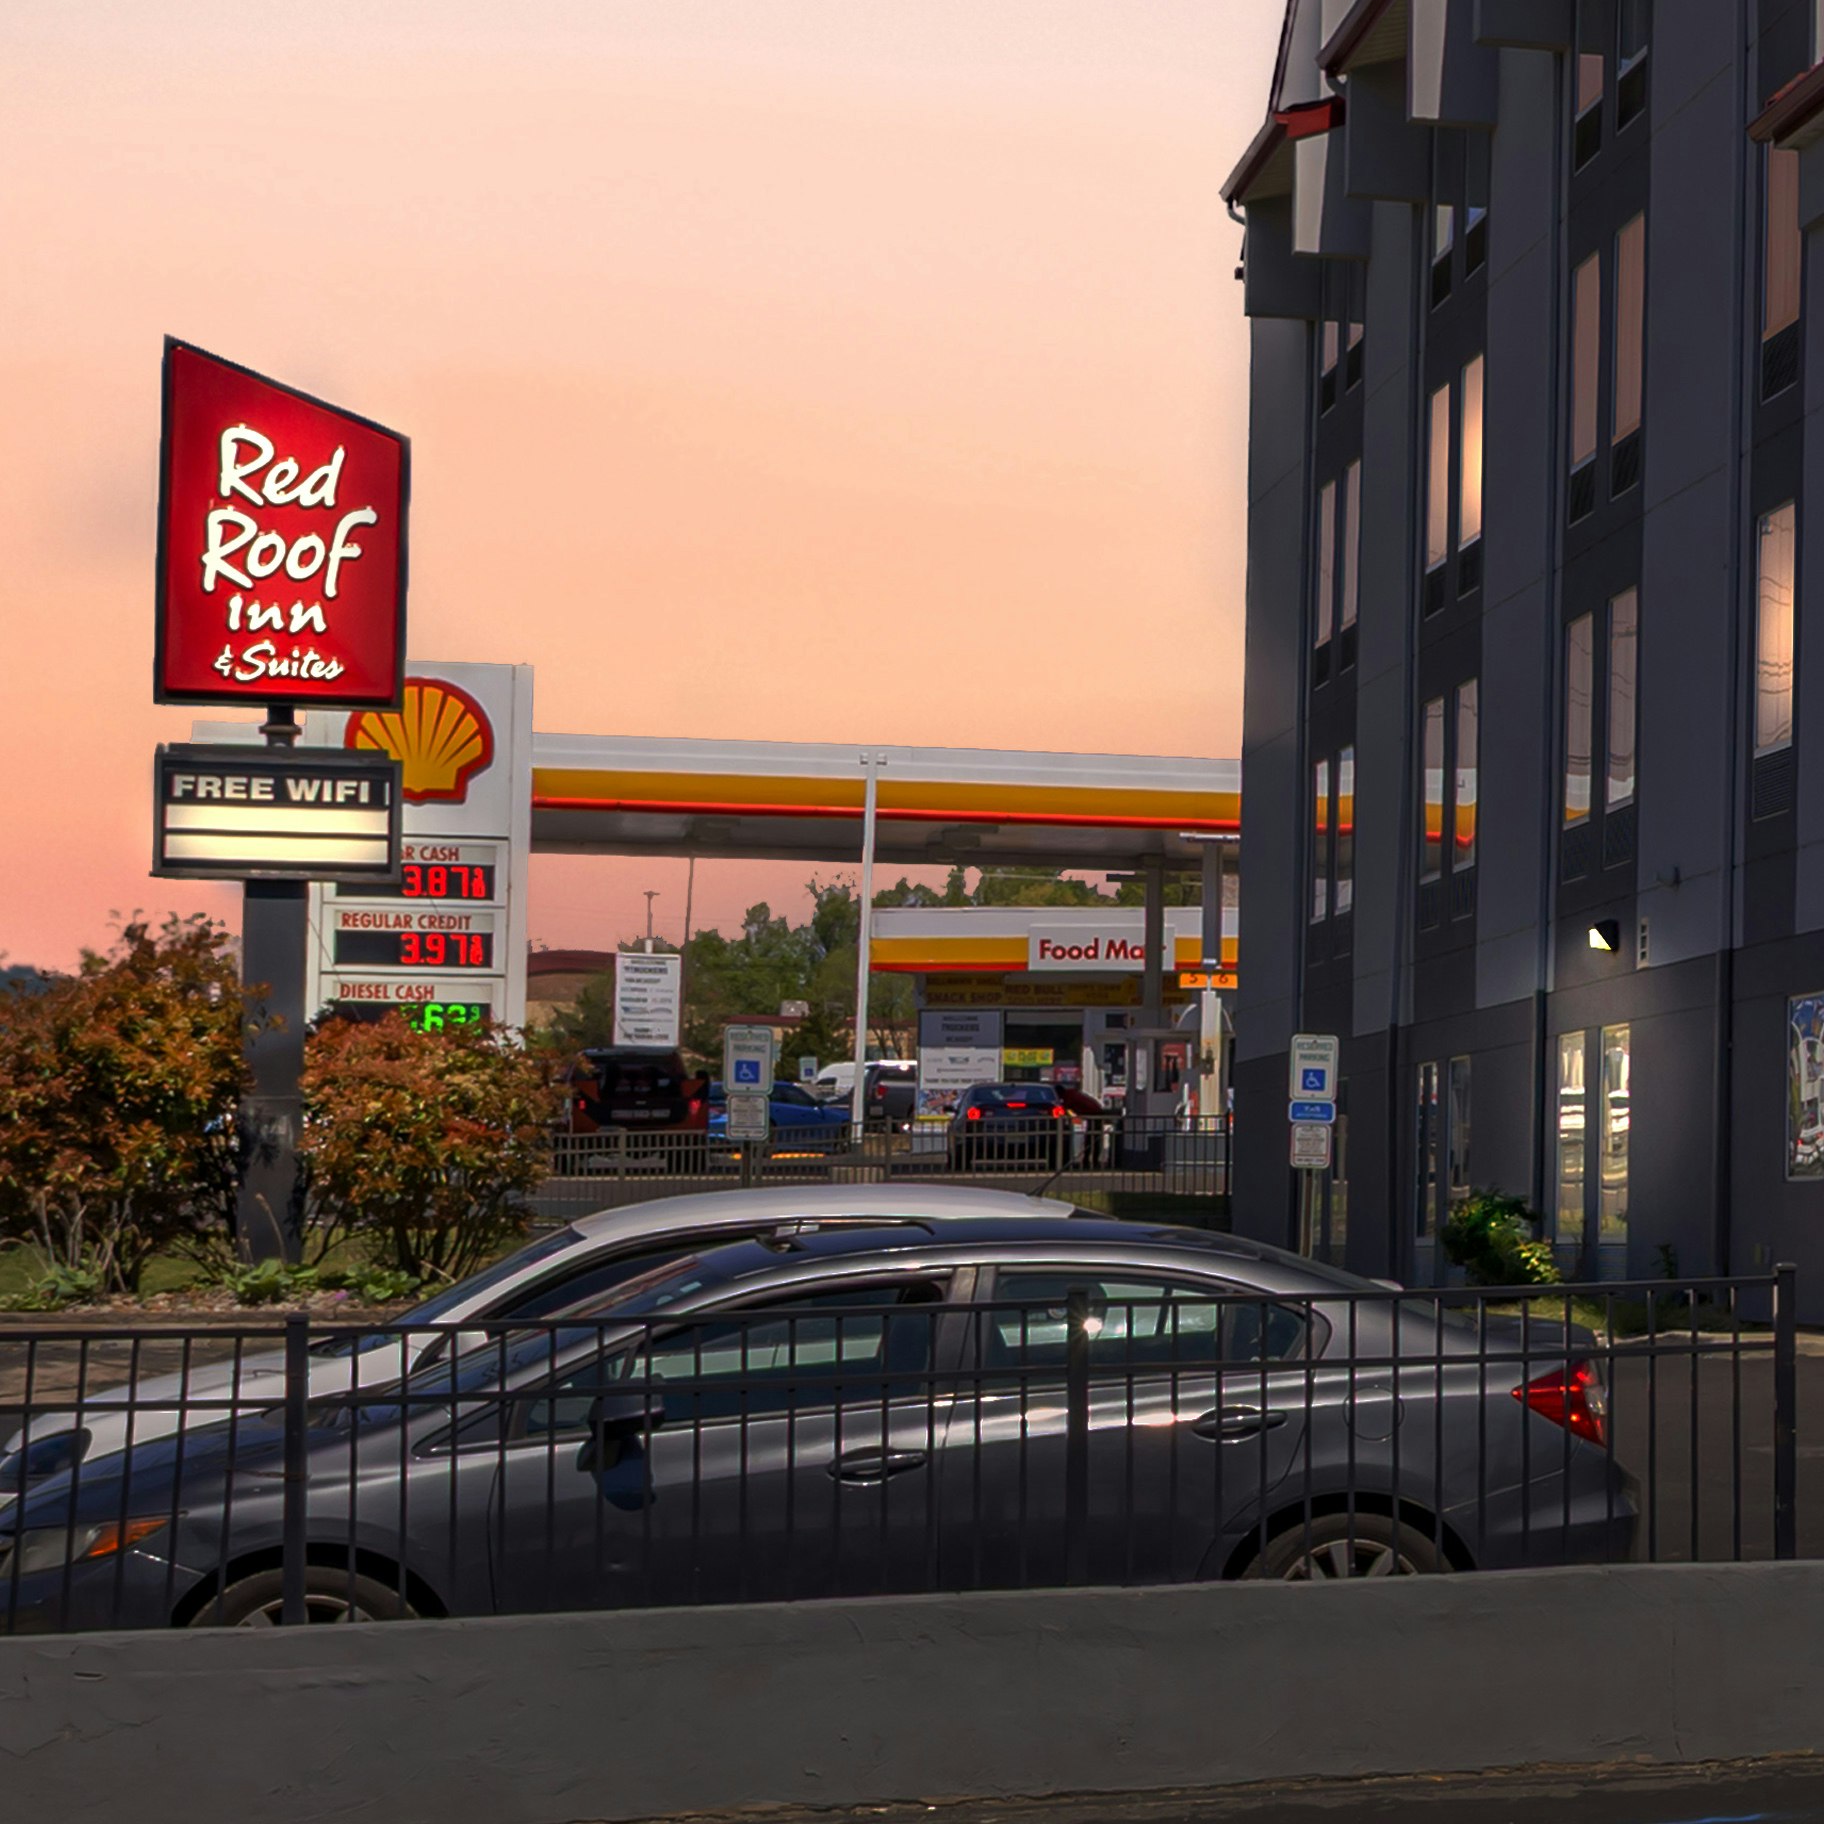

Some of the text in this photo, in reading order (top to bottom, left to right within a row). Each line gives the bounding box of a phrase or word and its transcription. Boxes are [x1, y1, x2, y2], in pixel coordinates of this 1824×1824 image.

[220, 423, 346, 508] Red
[202, 505, 378, 598] Roof
[227, 593, 328, 634] Inn
[173, 774, 370, 805] FREE WIFI
[419, 845, 460, 862] CASH
[341, 912, 472, 931] REGULAR CREDIT
[1039, 938, 1100, 961] Food
[339, 983, 435, 1002] DIESEL CASH
